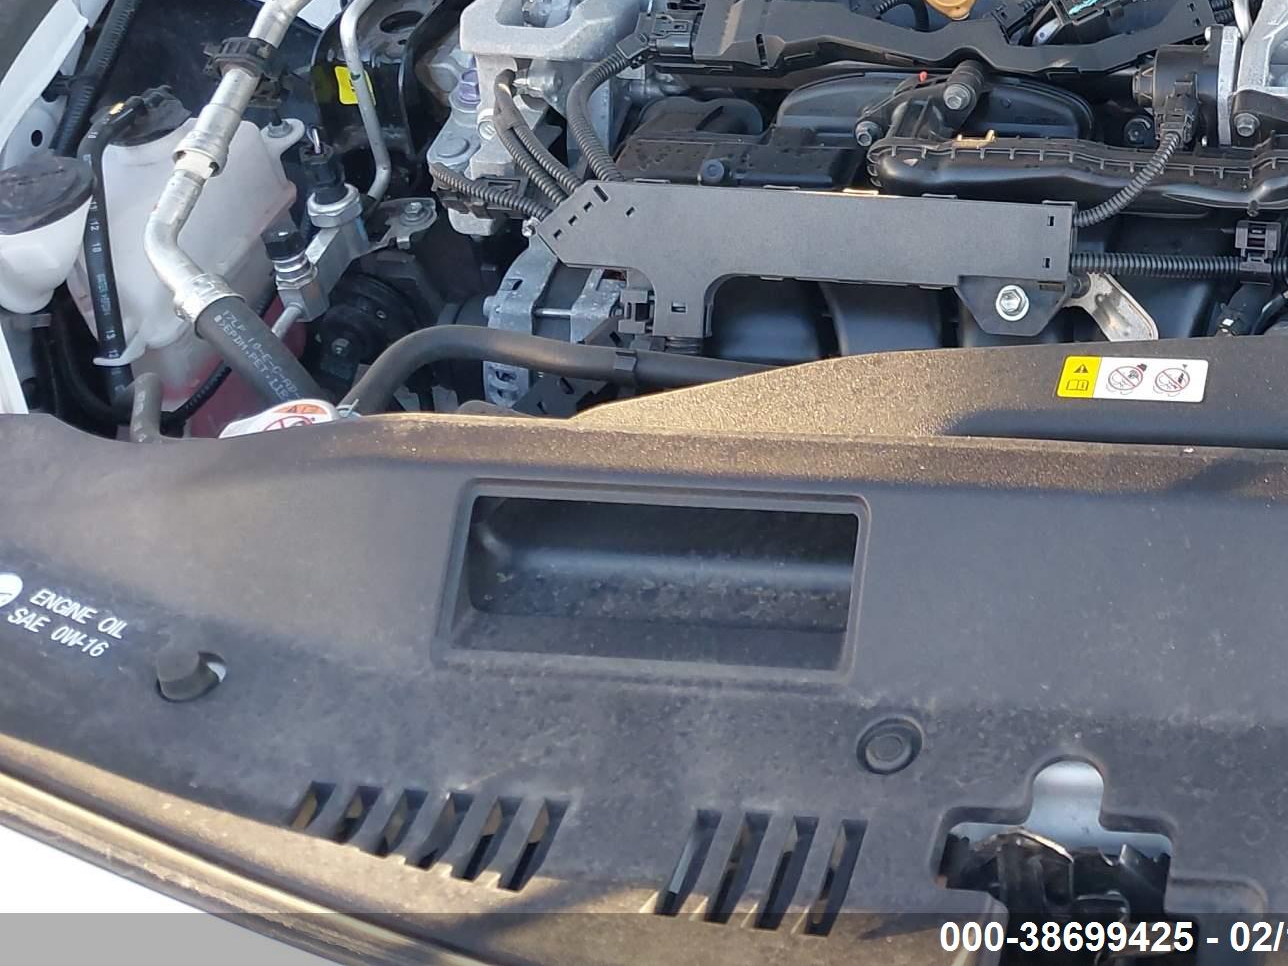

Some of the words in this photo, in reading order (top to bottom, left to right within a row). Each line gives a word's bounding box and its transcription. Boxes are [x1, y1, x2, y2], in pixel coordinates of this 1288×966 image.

[7, 608, 51, 633] SAE
[51, 625, 109, 658] 0W-16
[29, 587, 98, 625] ENGINE
[97, 617, 129, 640] OIL
